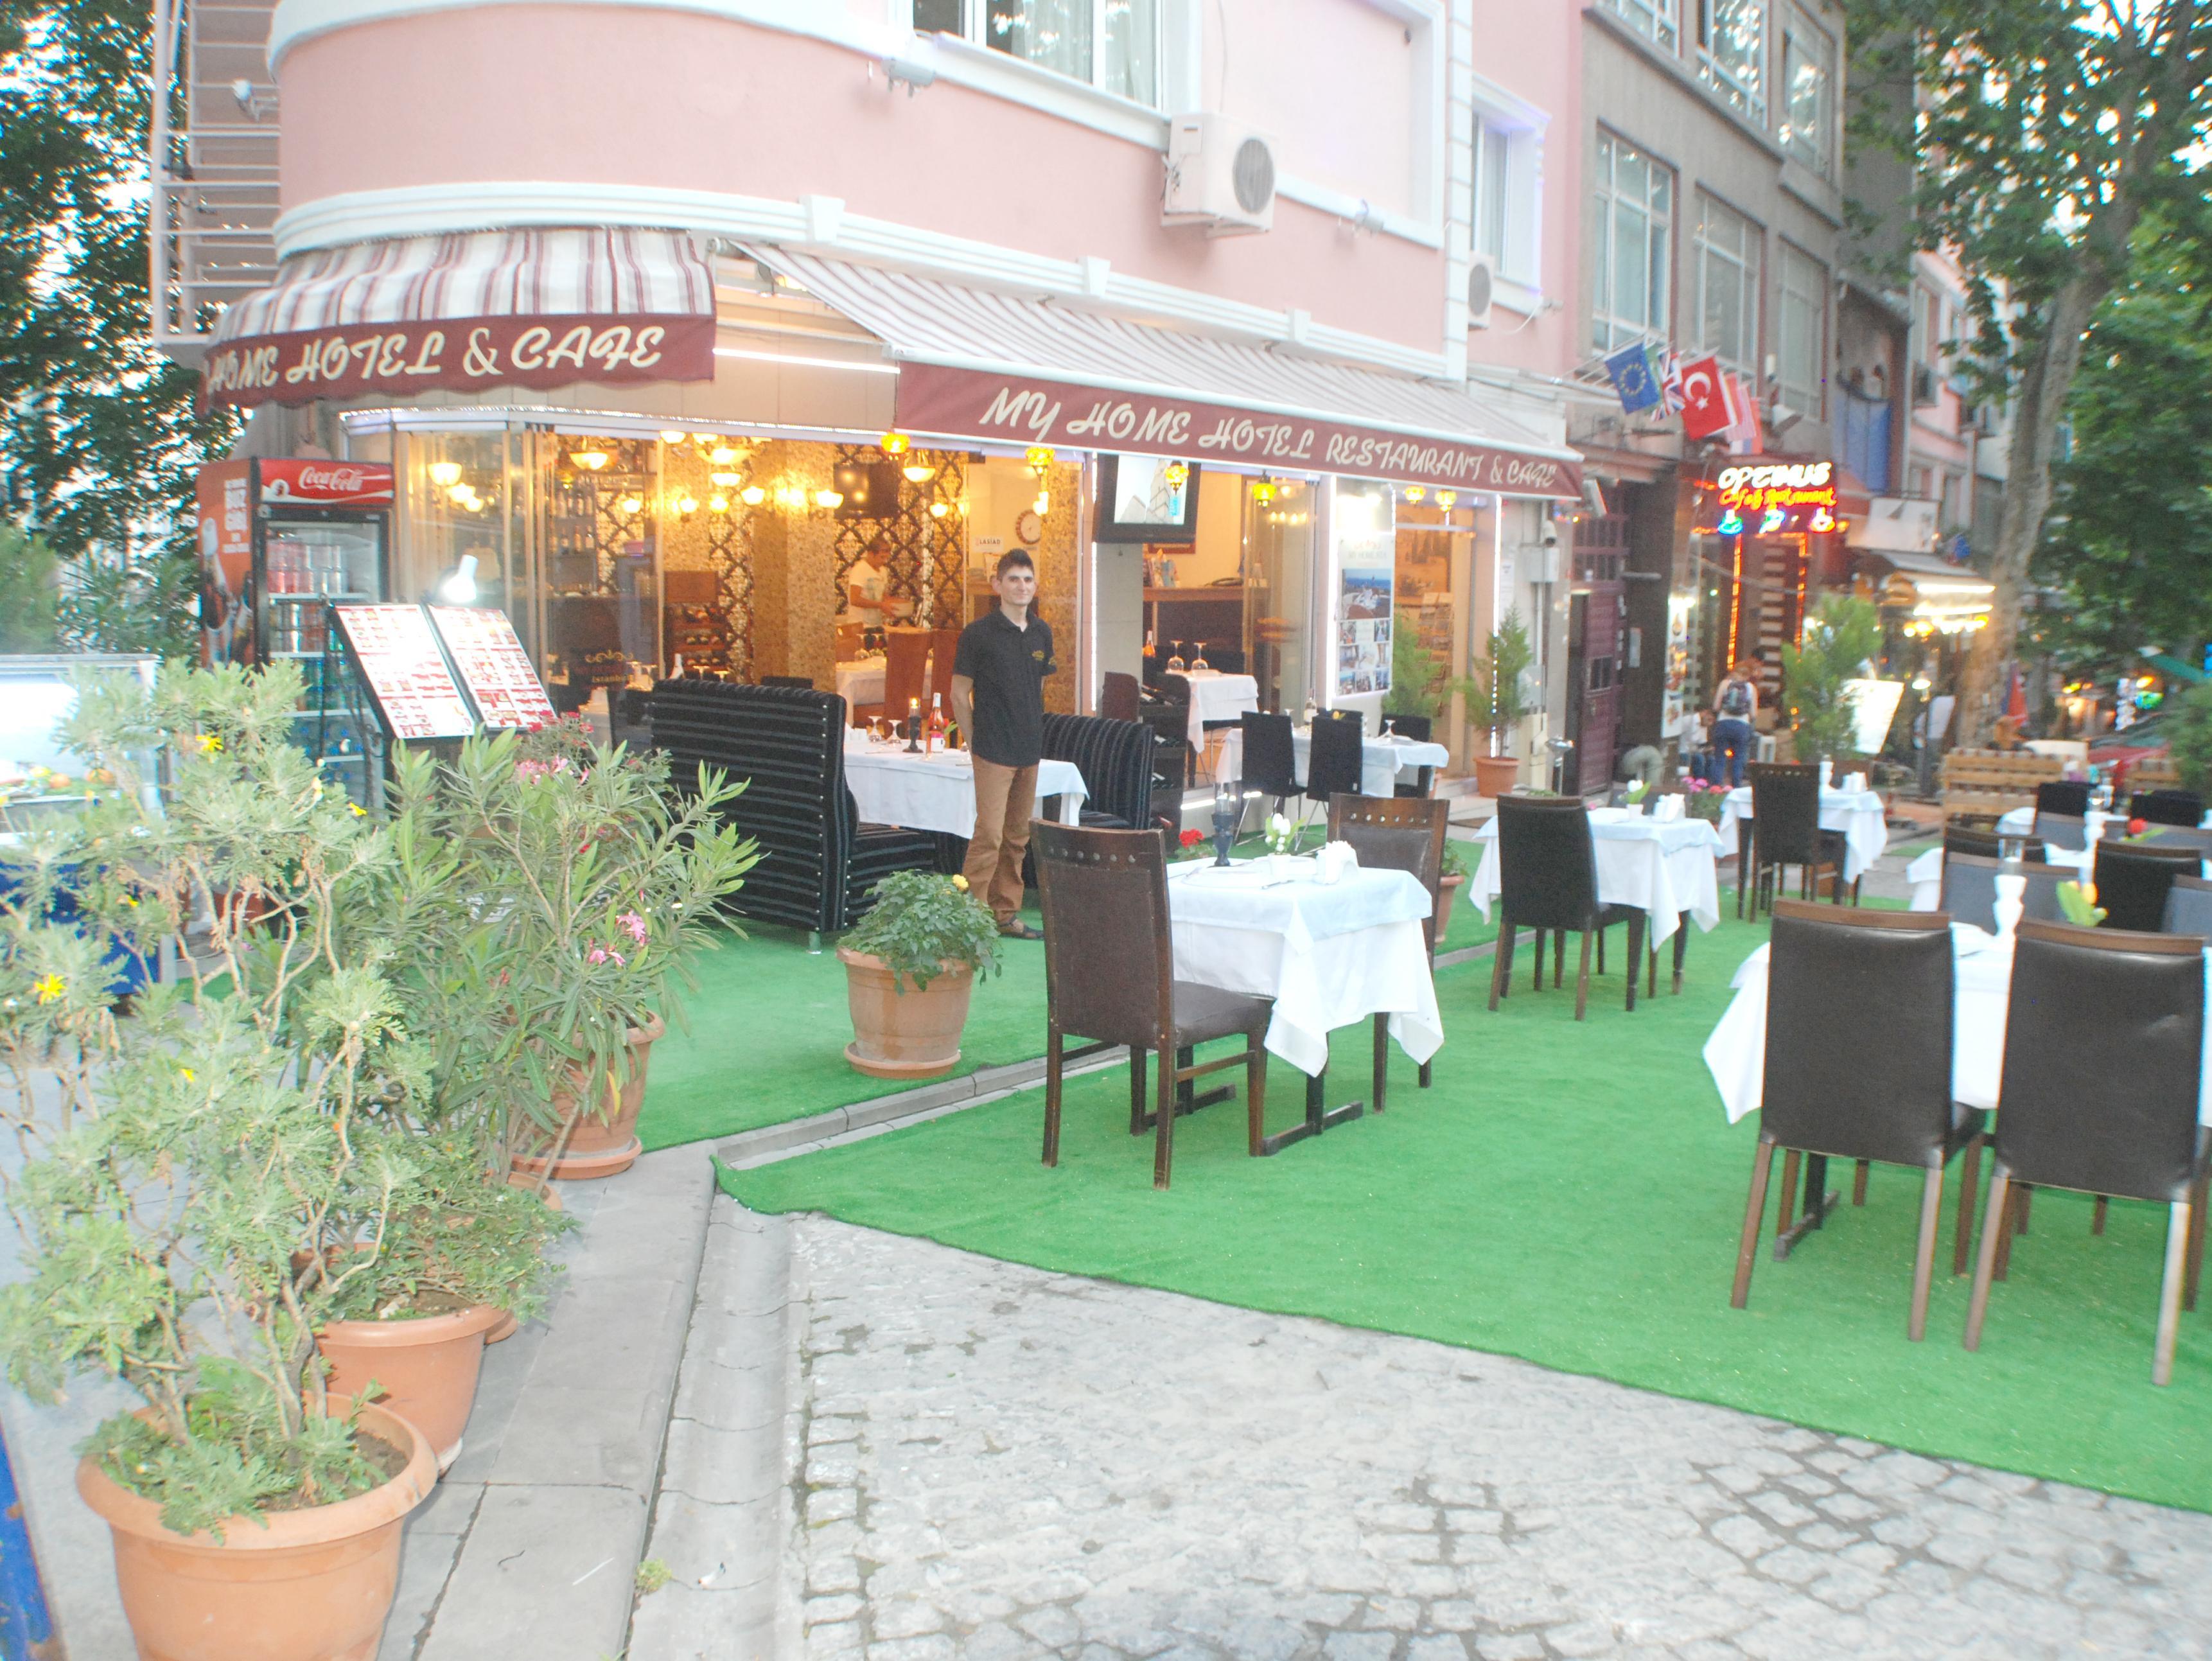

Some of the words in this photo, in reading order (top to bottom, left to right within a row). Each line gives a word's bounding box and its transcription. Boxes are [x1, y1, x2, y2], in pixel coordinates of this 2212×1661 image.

[207, 346, 278, 394] HOME
[285, 330, 444, 383] HOTEL
[462, 327, 504, 377] &
[511, 325, 665, 371] CAFE
[979, 387, 1062, 442] MY
[1066, 401, 1191, 444] HOME
[1198, 417, 1315, 459] HOTEL
[1325, 433, 1485, 481] RESTAURANT
[1490, 455, 1504, 484] &
[1507, 461, 1558, 489] CAFE
[1718, 462, 1832, 494] OPTIMUS
